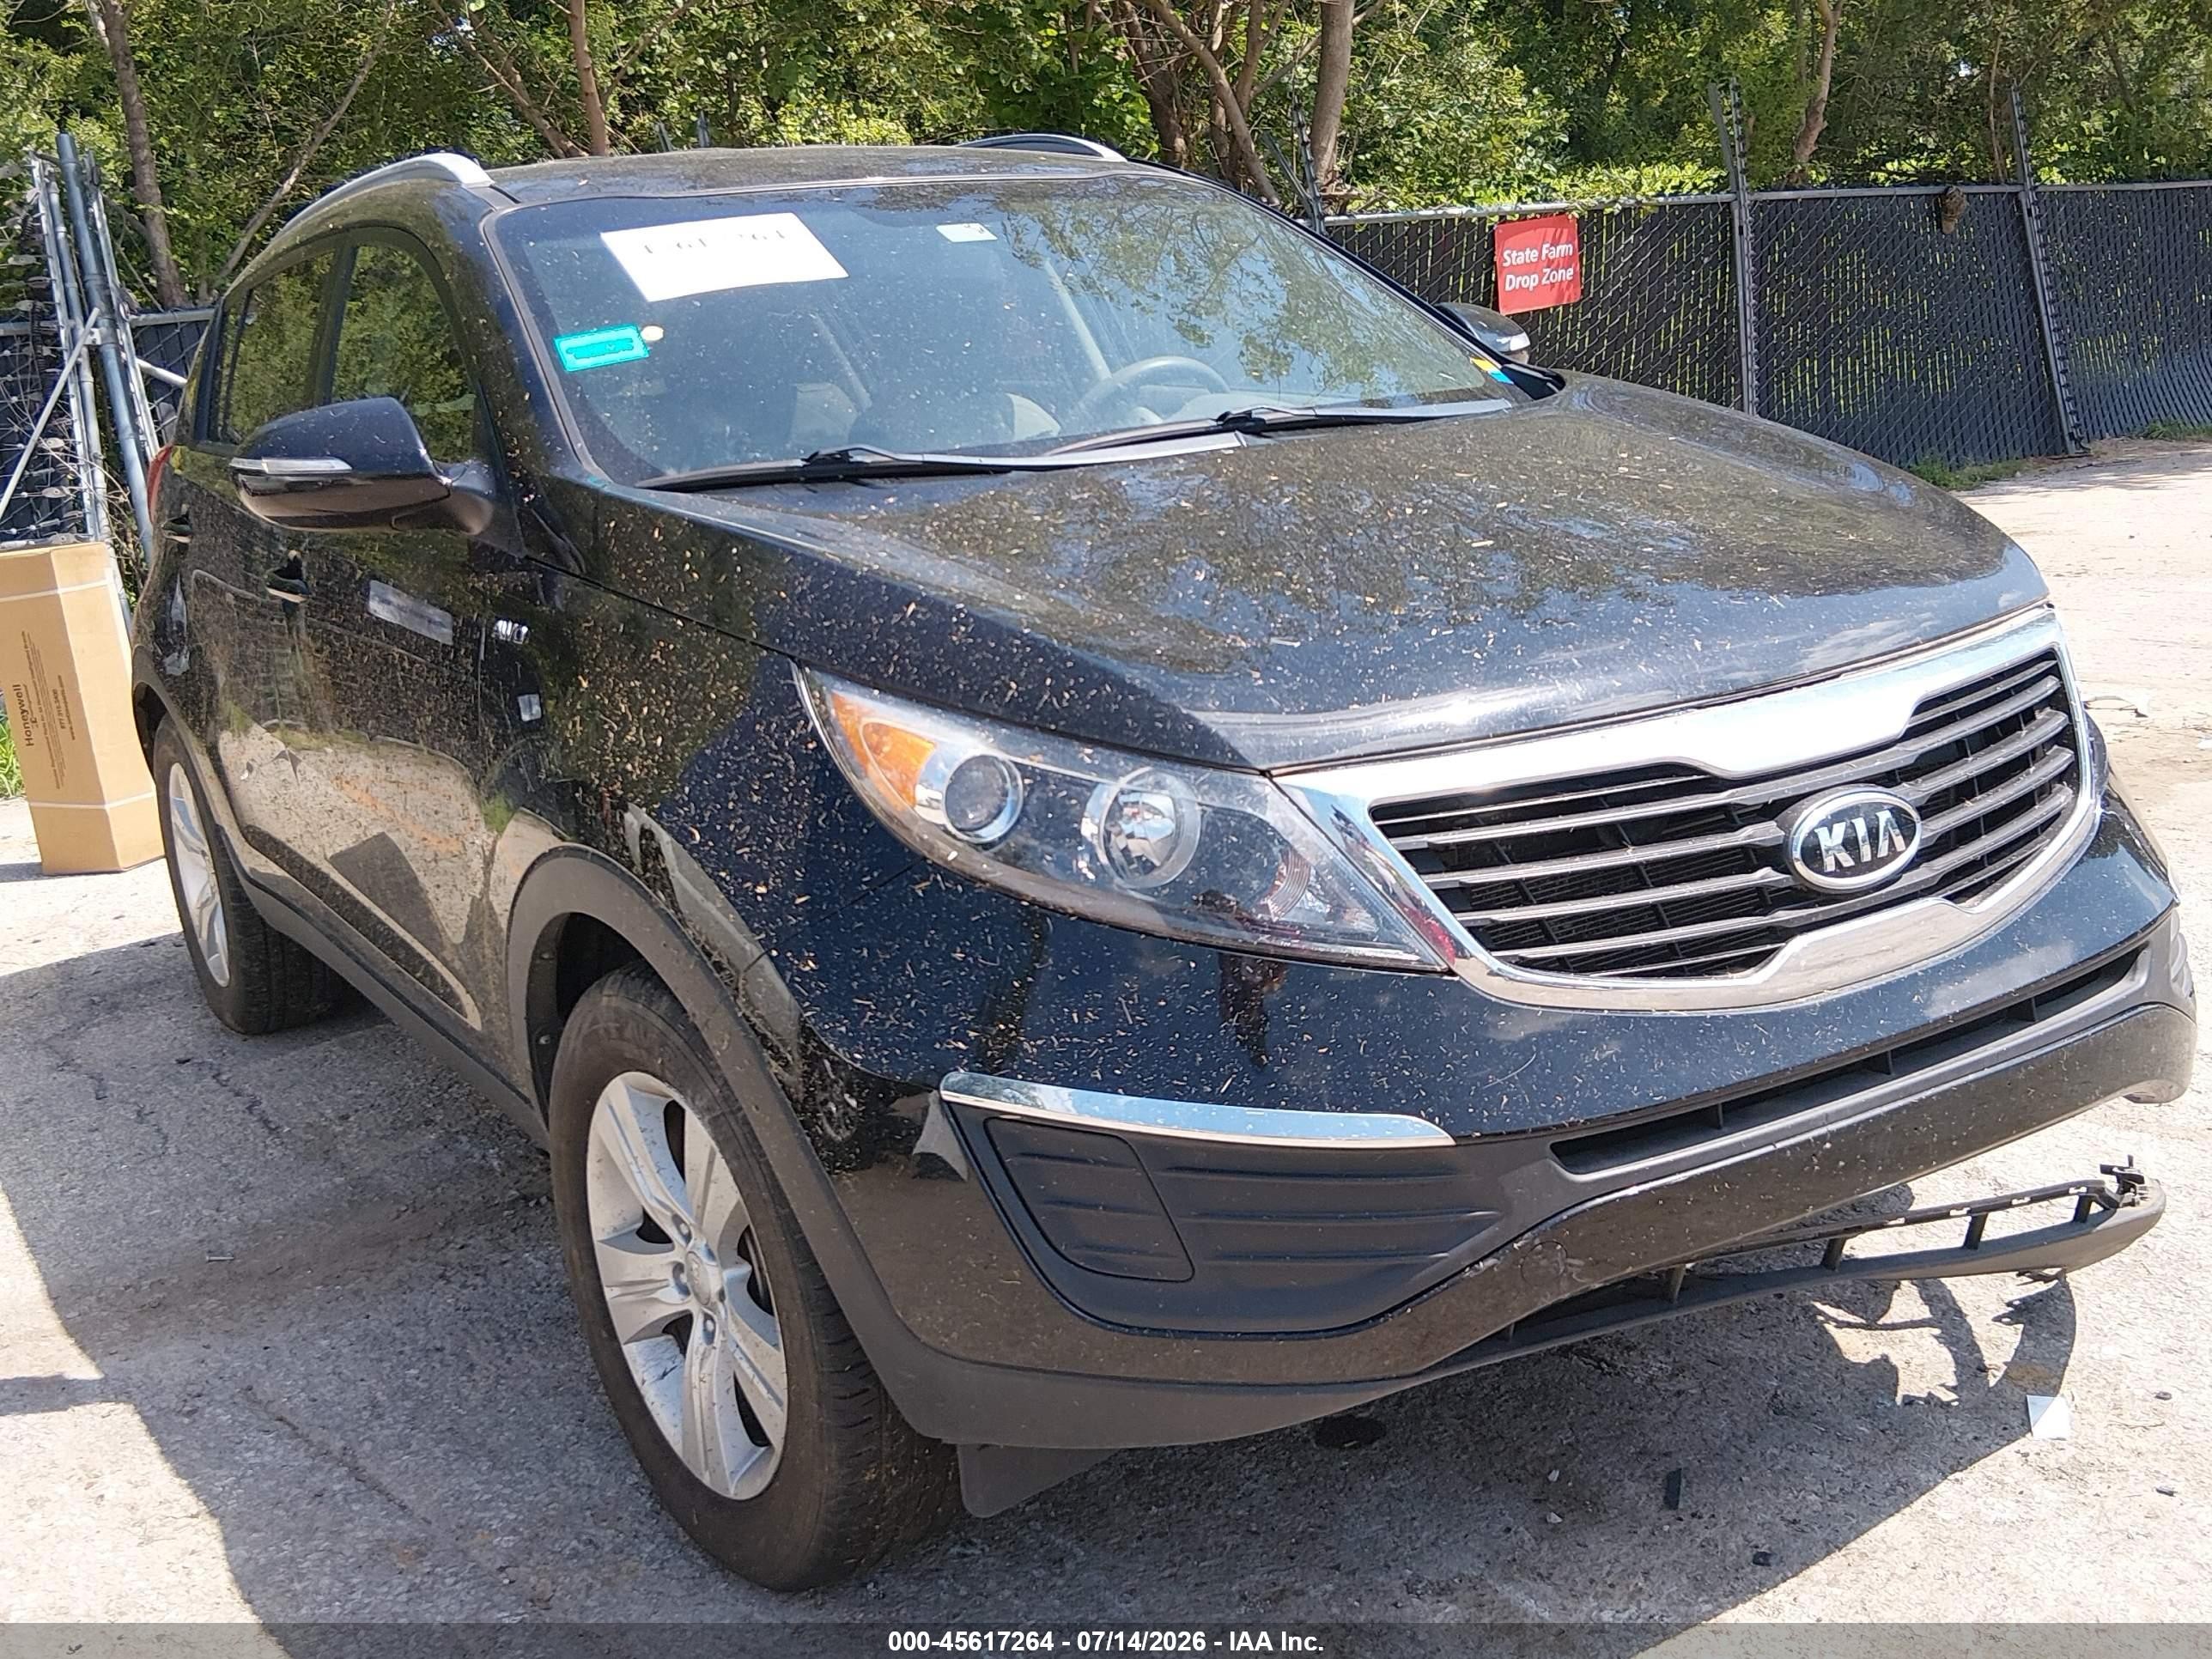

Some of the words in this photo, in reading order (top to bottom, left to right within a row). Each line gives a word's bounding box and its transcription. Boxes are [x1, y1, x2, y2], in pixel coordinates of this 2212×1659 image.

[1502, 246, 1539, 267] State
[1541, 243, 1573, 260] Farm
[1504, 273, 1539, 292] Drop
[1541, 266, 1574, 285] Zone
[12, 684, 34, 746] Honeywell
[1814, 810, 1906, 872] KIA
